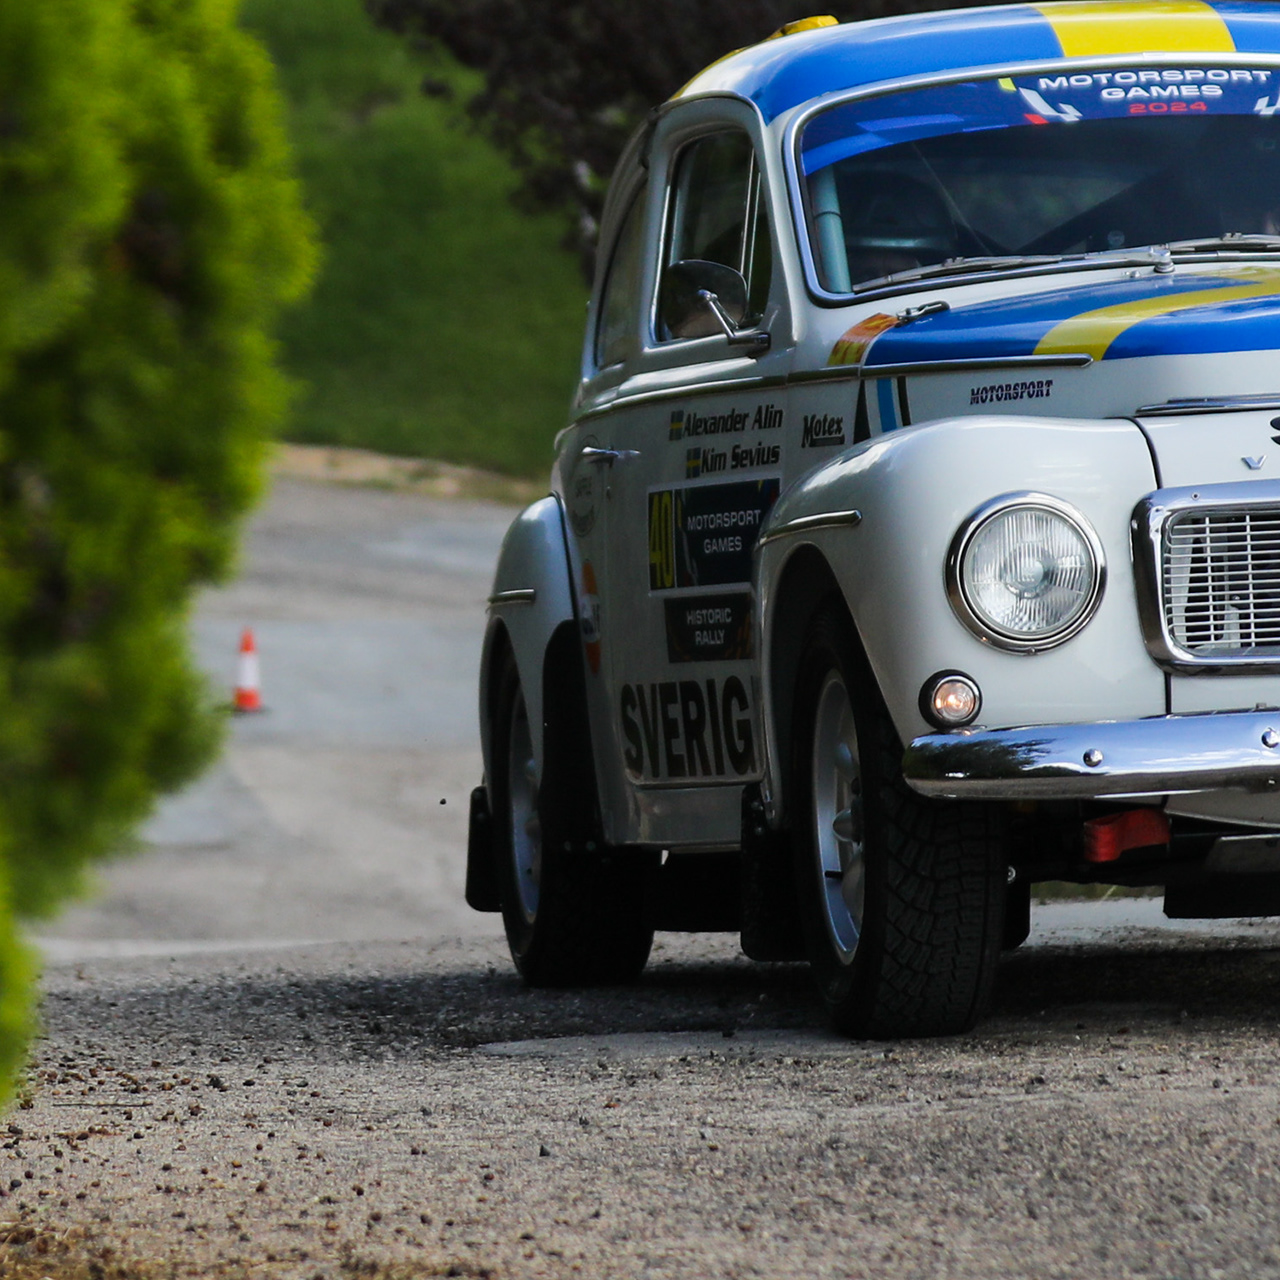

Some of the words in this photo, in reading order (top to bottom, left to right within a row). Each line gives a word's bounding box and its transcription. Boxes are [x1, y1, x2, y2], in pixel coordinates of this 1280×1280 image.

[1038, 70, 1271, 89] MOTORSPORT
[1100, 84, 1223, 100] GAMES
[1129, 101, 1208, 114] 2024
[969, 379, 1054, 406] MOTORSPORT
[683, 408, 749, 438] Alexander
[752, 403, 783, 431] Alin
[800, 413, 845, 449] Motex
[701, 445, 727, 473] Kim
[731, 441, 781, 469] Sevius
[687, 509, 761, 531] MOTORSPORT
[650, 490, 674, 589] 40
[703, 536, 743, 554] GAMES
[686, 607, 733, 626] HISTORIC
[694, 628, 726, 646] RALLY
[621, 675, 761, 778] SVERIG
